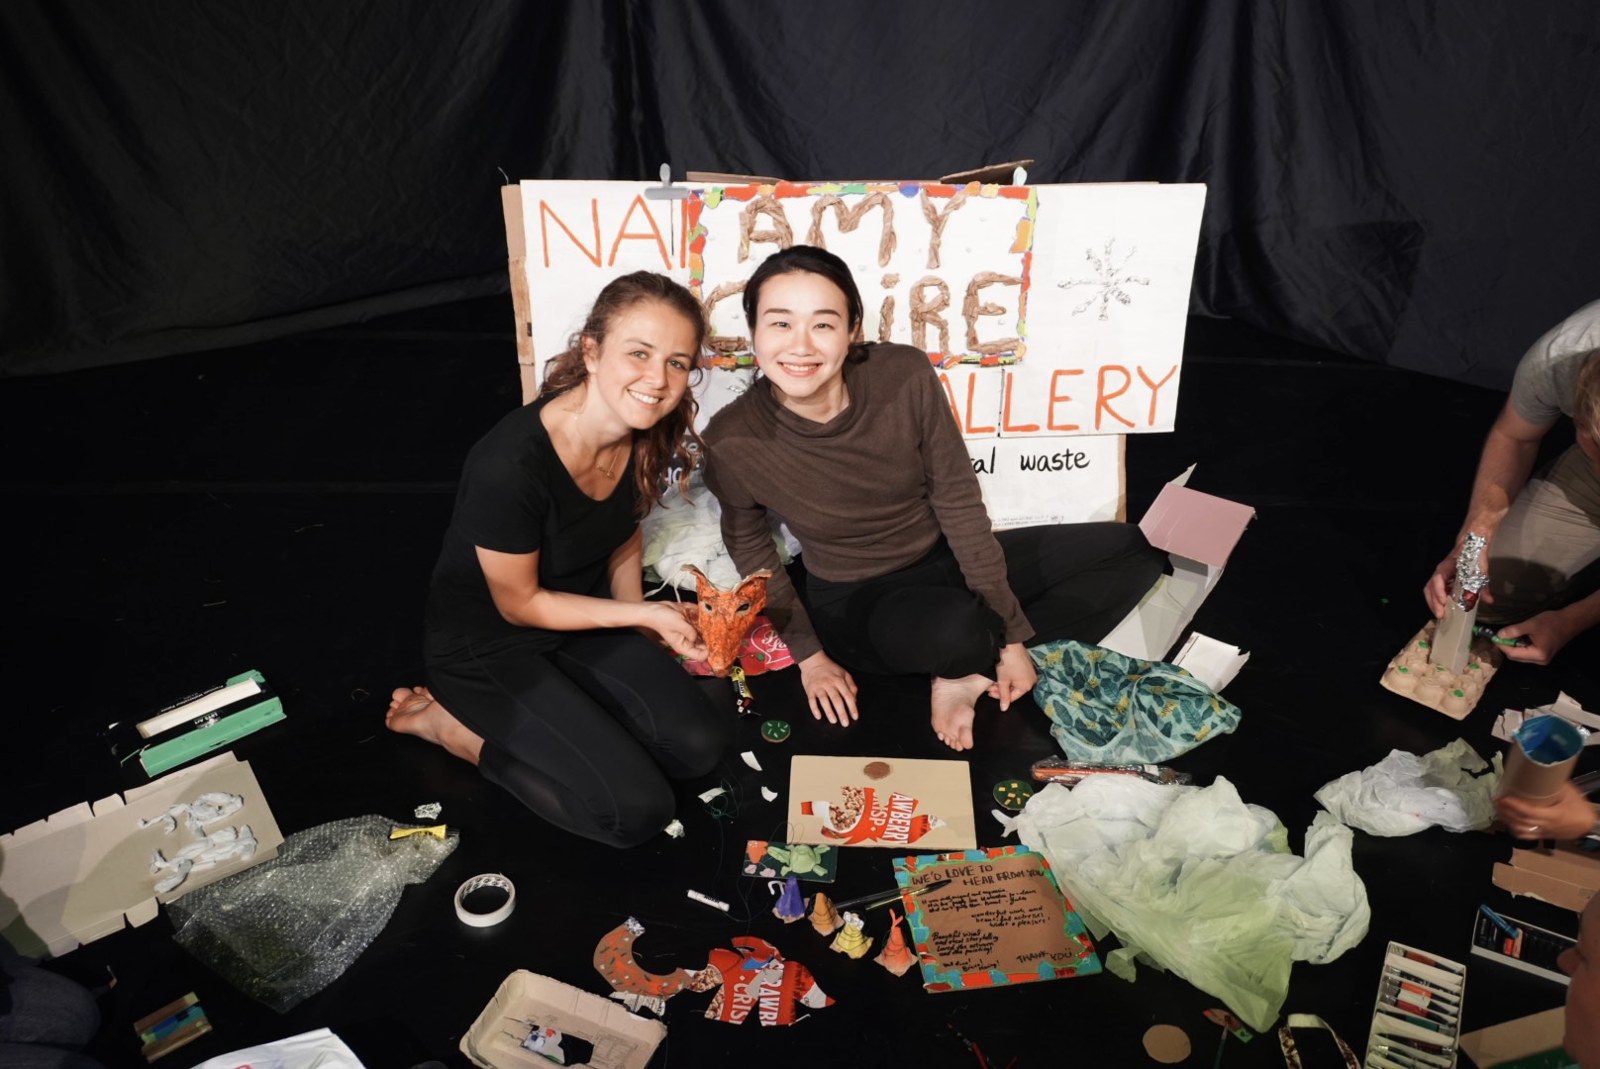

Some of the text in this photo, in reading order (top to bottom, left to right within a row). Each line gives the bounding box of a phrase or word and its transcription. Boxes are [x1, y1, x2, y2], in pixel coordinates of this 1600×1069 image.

[737, 187, 967, 270] AMY
[971, 445, 1091, 474] al waste
[912, 864, 993, 885] WE'D LOVE TO
[963, 868, 1045, 887] HEAR FROM YOU
[1016, 951, 1050, 963] THANK
[729, 983, 756, 1025] CRIS
